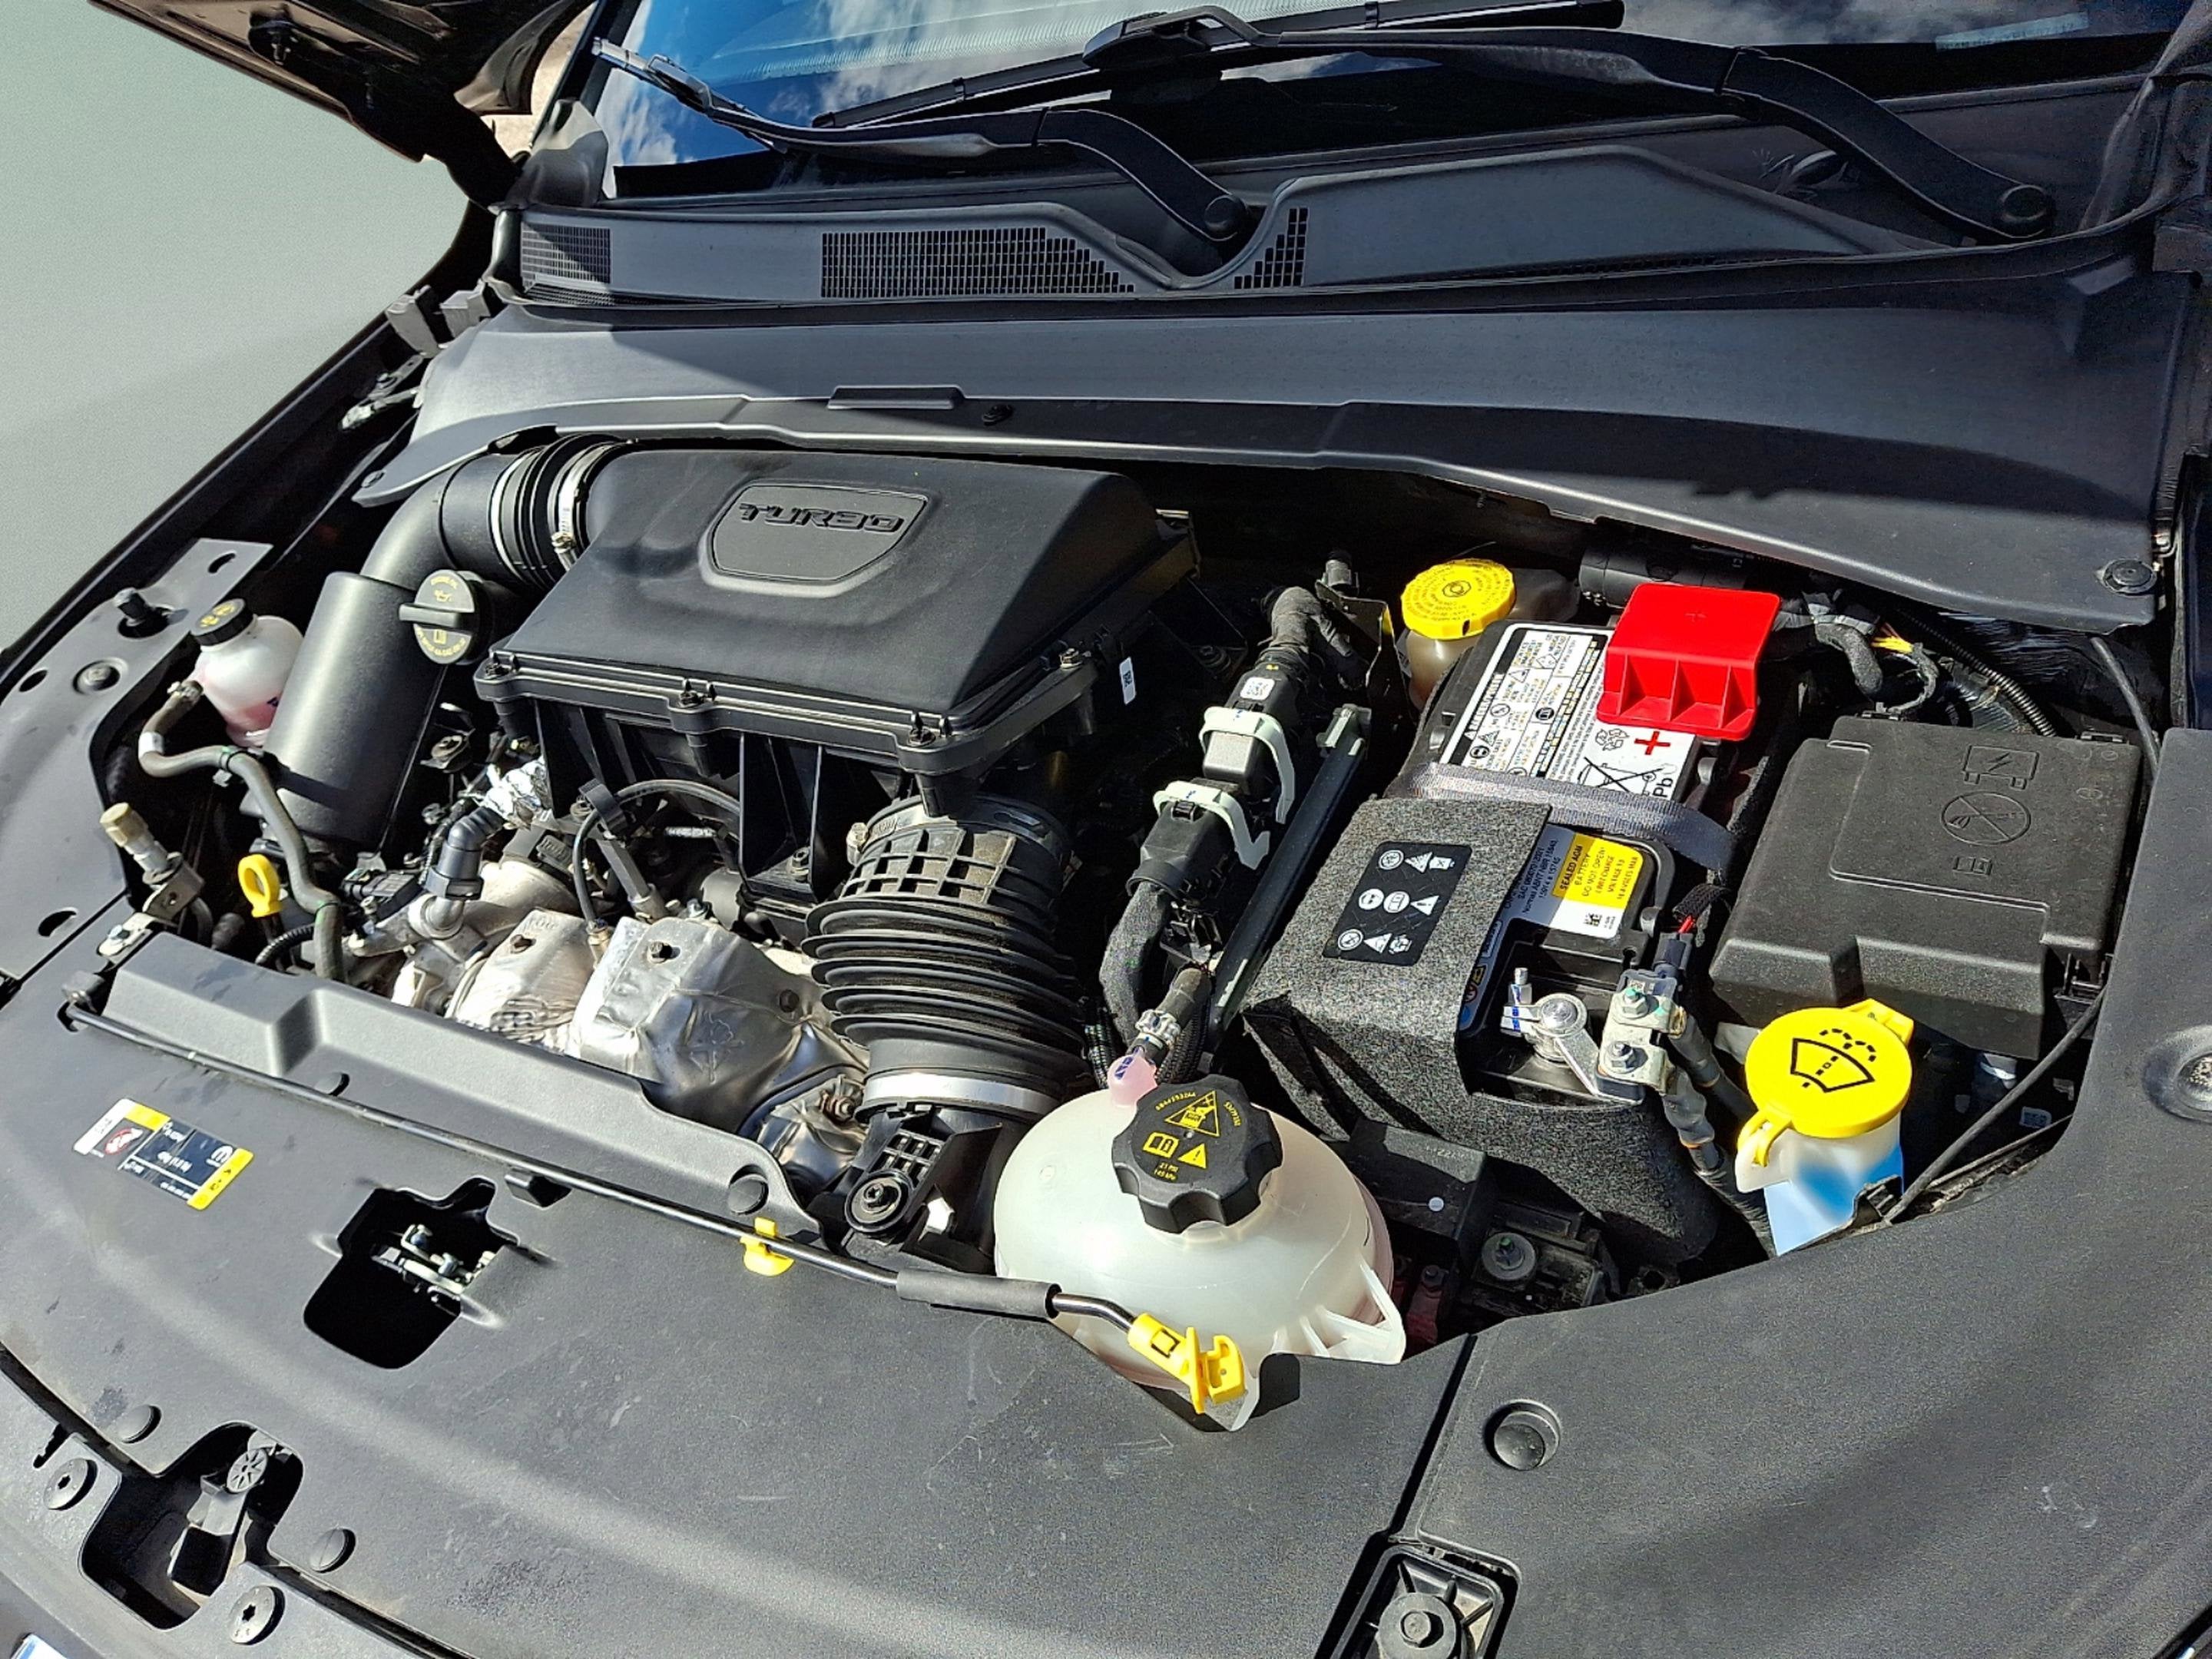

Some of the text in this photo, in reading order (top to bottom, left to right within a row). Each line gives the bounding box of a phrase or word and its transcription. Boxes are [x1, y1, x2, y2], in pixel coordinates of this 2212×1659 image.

[739, 502, 905, 533] TURBO
[1653, 777, 1673, 798] Pb
[1560, 845, 1583, 890] SEALED AGM
[1575, 854, 1591, 886] BATTERY
